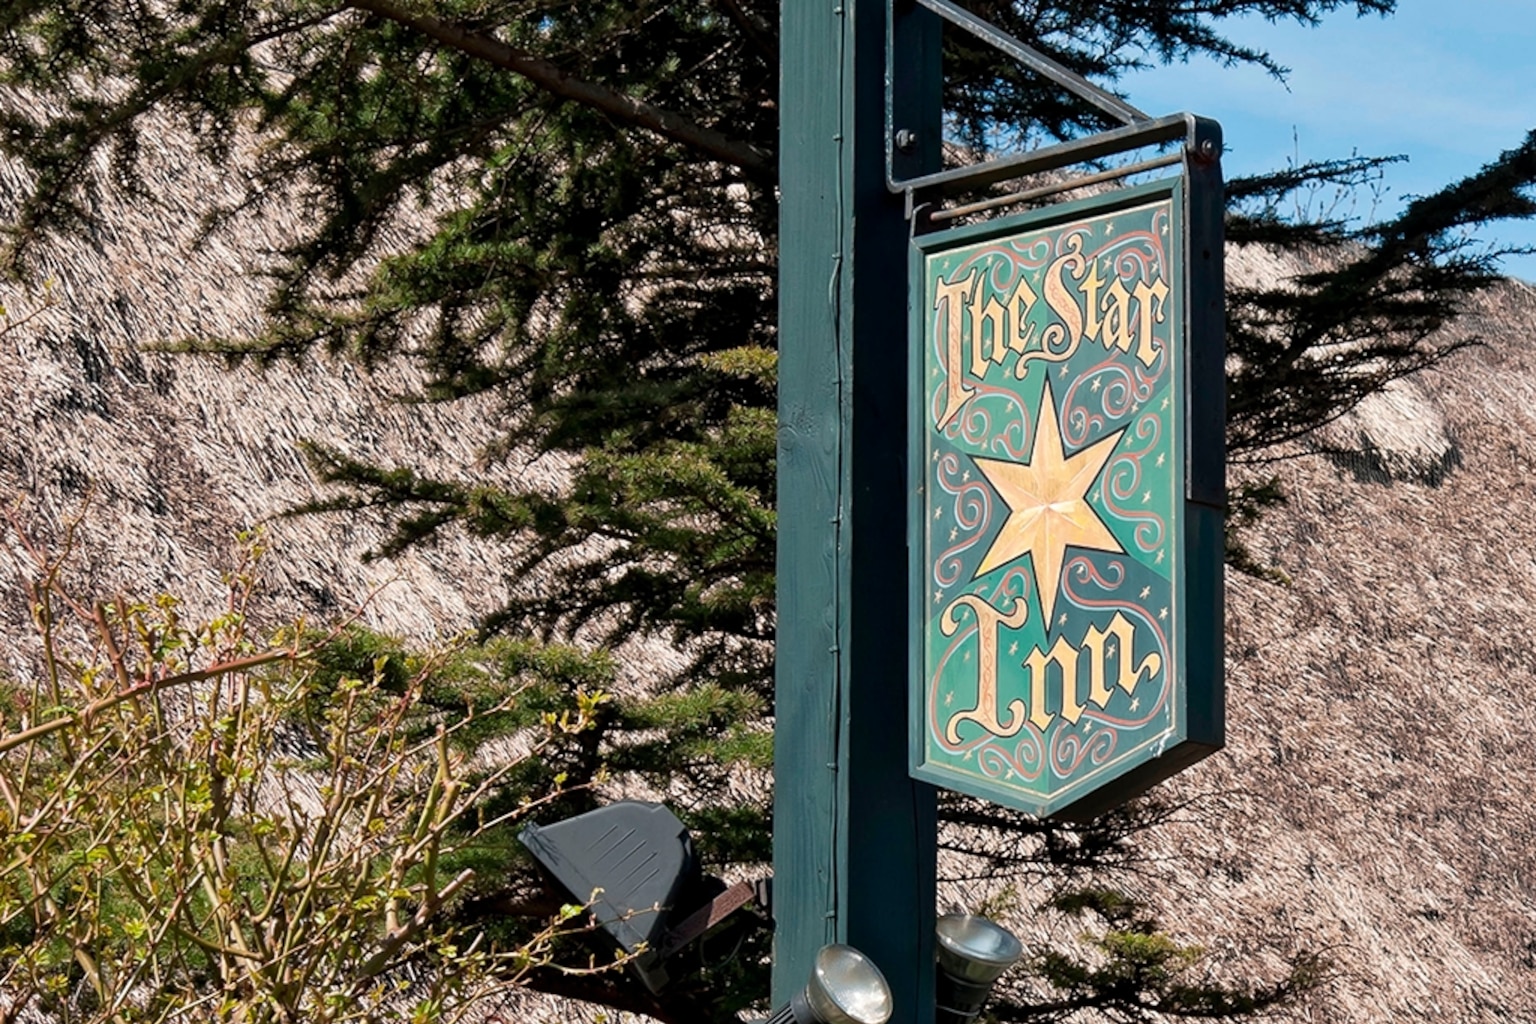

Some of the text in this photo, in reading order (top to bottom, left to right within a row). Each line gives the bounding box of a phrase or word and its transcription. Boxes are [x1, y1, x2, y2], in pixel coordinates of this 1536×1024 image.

[932, 232, 1171, 433] The Star
[940, 591, 1161, 746] Inn
